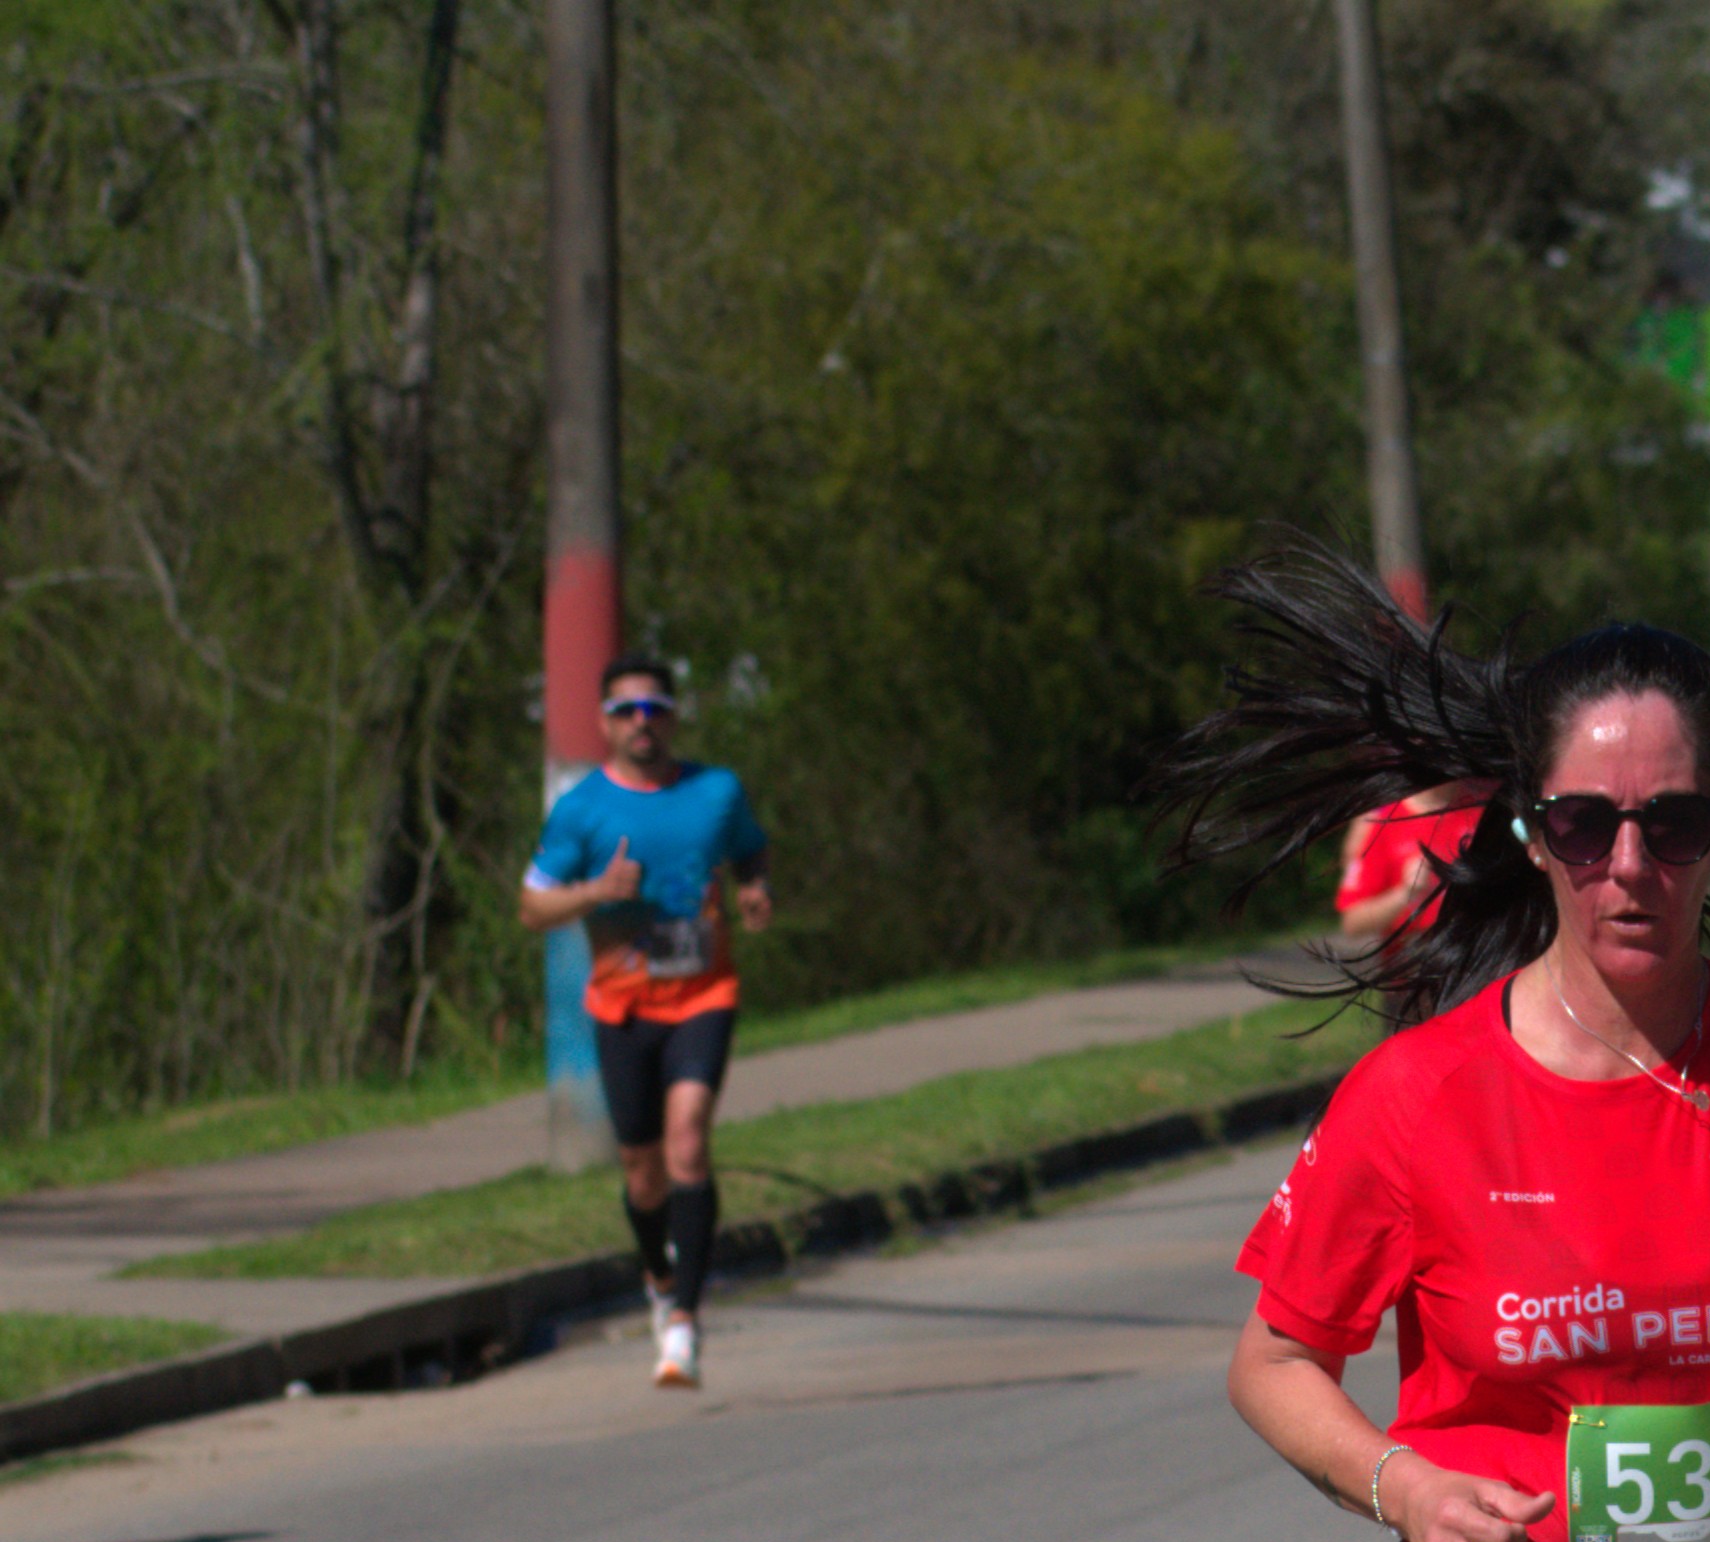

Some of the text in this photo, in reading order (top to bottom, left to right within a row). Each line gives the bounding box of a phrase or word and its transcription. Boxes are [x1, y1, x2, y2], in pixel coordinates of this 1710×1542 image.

[1503, 1190, 1556, 1204] EDICIÓN
[1496, 1283, 1625, 1321] Corrida
[1494, 1317, 1609, 1366] SAN
[1669, 1354, 1685, 1366] LA
